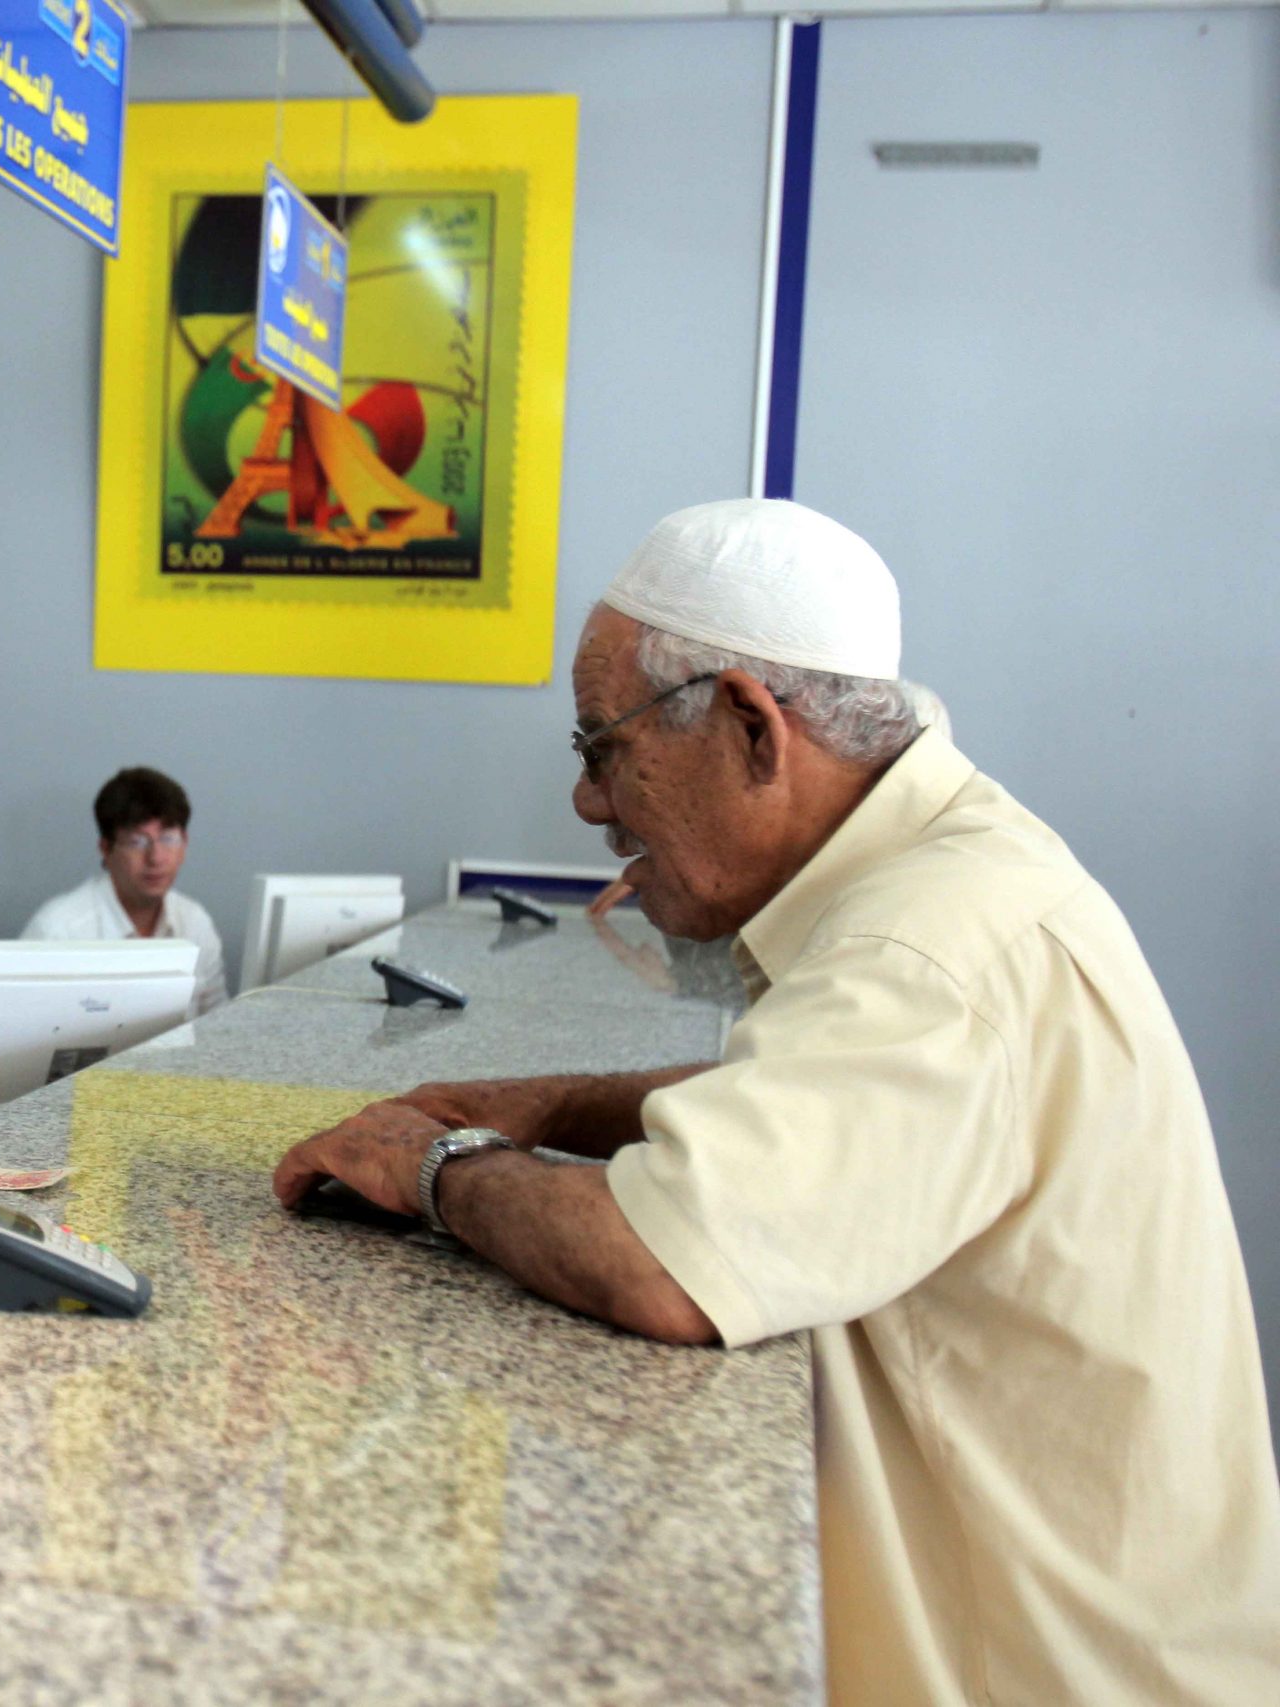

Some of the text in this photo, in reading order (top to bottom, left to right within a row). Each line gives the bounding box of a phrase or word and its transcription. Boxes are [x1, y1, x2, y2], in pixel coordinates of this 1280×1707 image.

[73, 0, 95, 62] 2
[5, 123, 33, 171] LES
[33, 145, 115, 230] OPERATIONS
